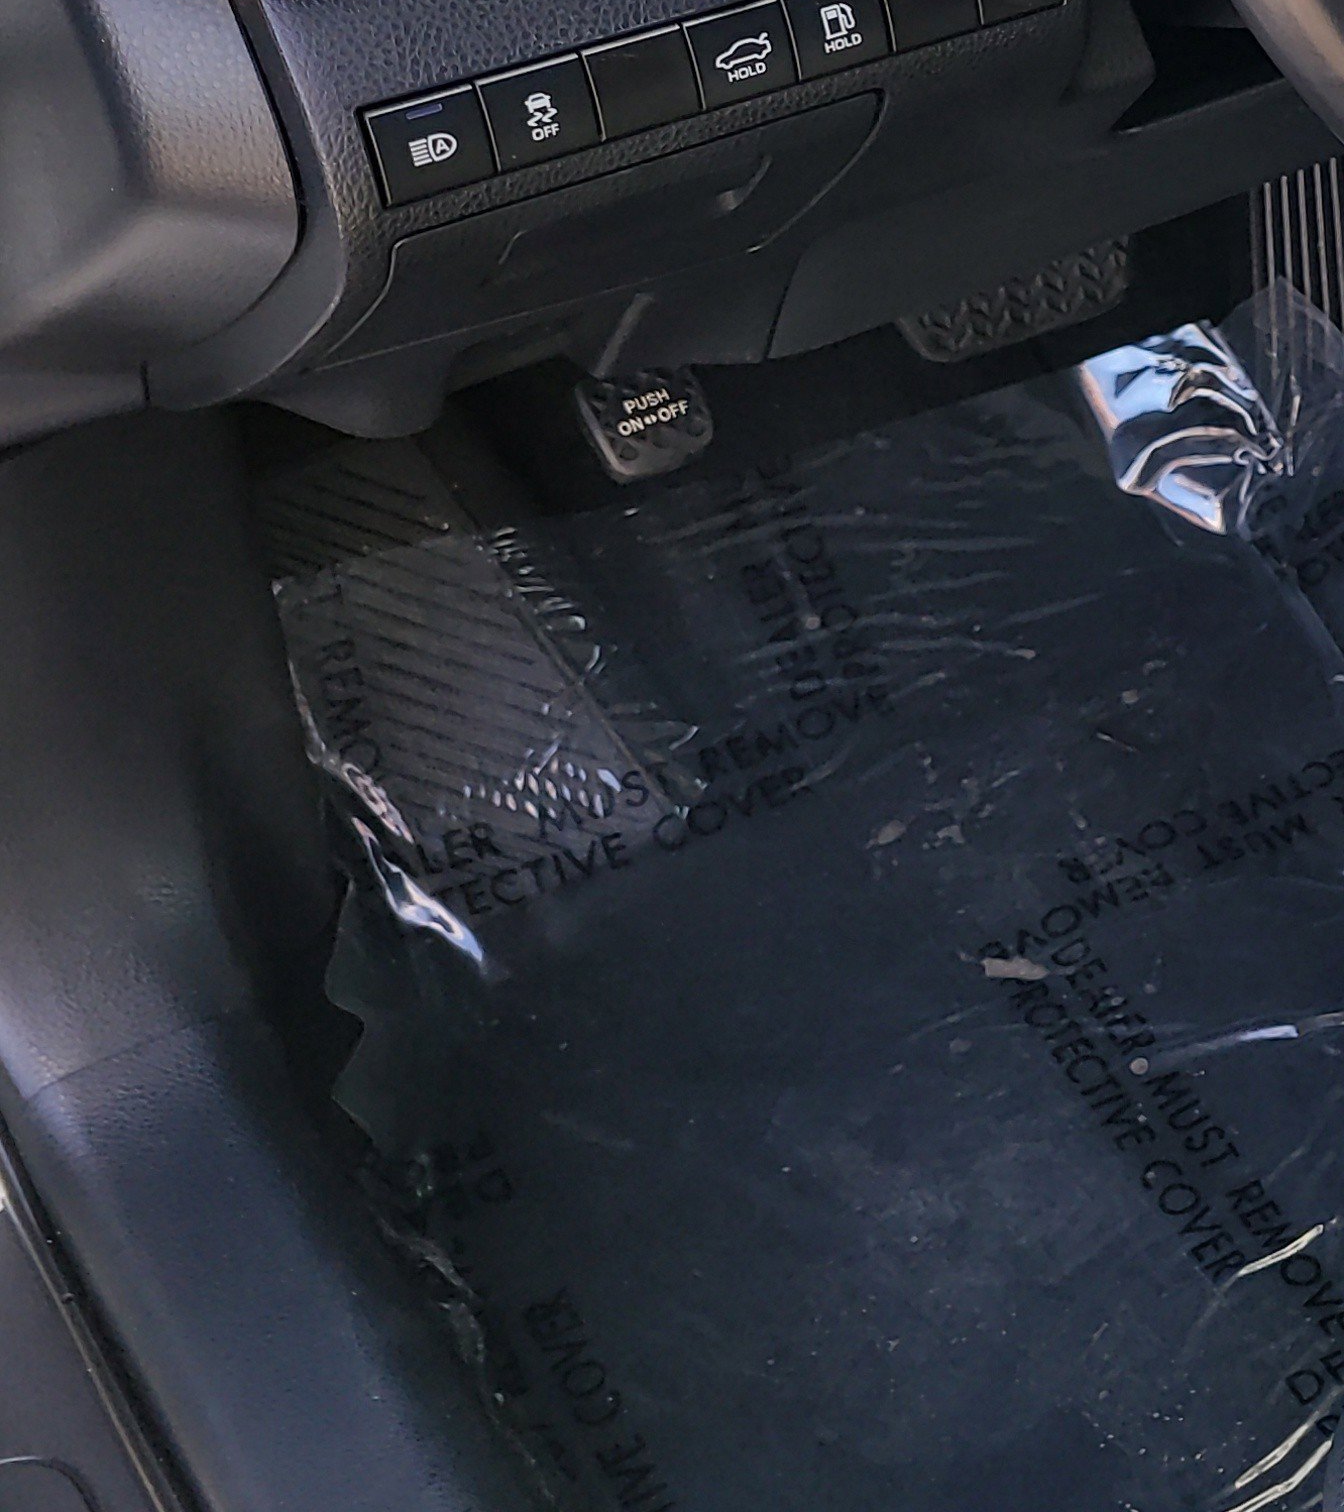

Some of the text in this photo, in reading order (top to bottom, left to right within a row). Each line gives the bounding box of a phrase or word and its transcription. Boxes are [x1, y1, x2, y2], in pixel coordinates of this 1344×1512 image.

[824, 33, 863, 54] HOLD
[728, 61, 767, 83] HOLD
[531, 123, 560, 142] OFF
[623, 388, 672, 415] PUSH
[617, 399, 689, 437] ON OFF
[1140, 1068, 1240, 1171] MUST
[1135, 1152, 1249, 1286] COVER
